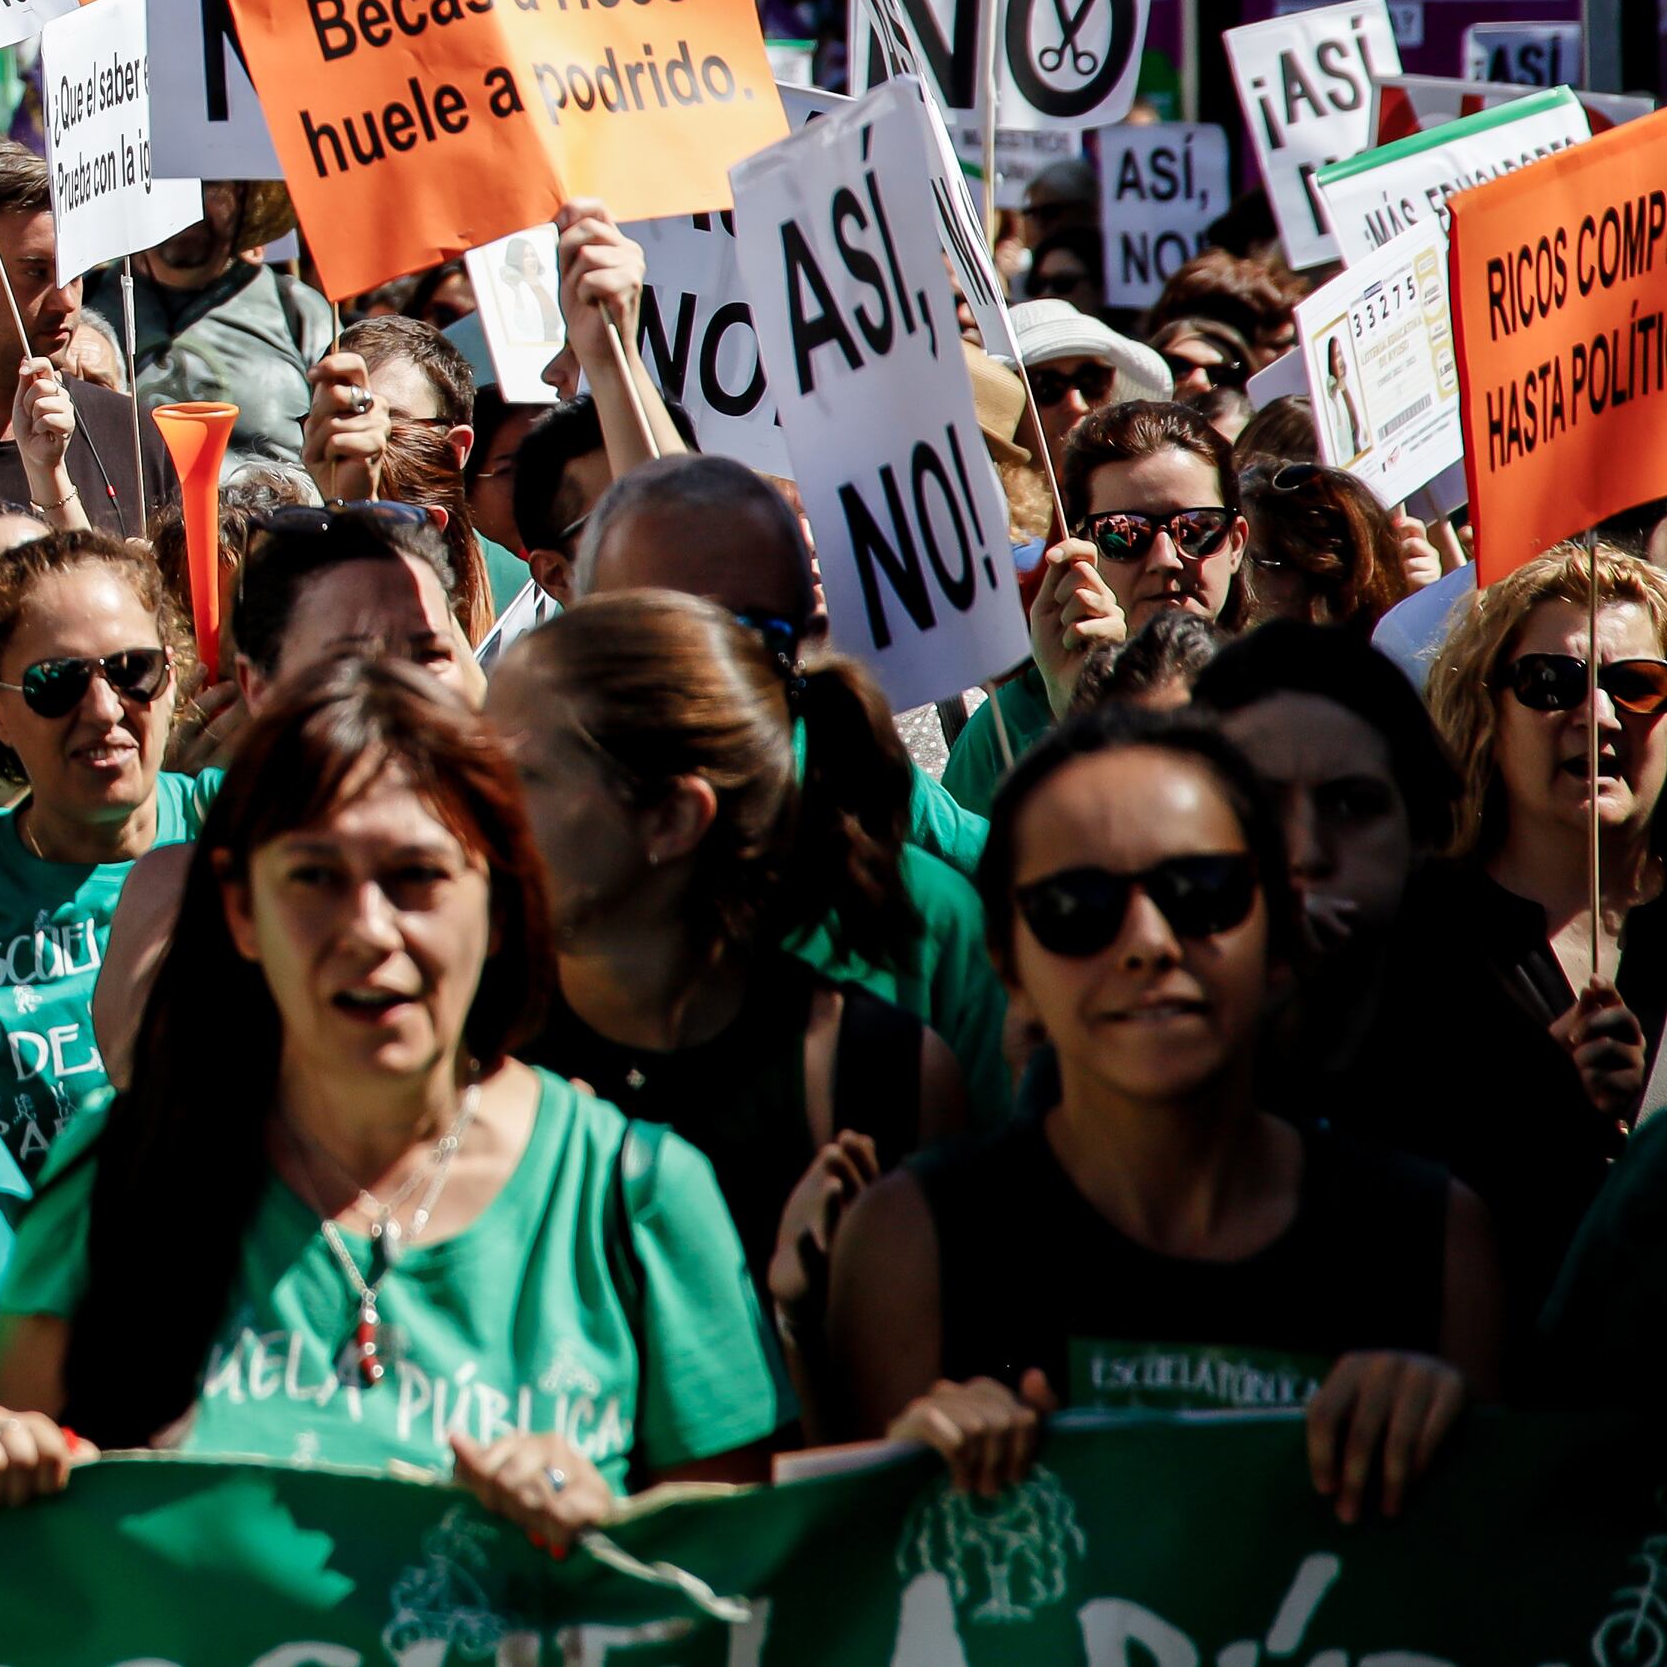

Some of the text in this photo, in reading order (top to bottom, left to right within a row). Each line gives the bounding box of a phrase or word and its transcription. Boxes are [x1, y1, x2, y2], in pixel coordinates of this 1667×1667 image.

[54, 52, 140, 149] ¿Que el saber
[299, 41, 754, 178] huele a podrido.
[1252, 15, 1378, 151] ¡ASÍ
[54, 151, 91, 234] ¡Prueba
[93, 149, 117, 195] con
[120, 133, 136, 189] la
[1117, 132, 1210, 211] ASÍ,
[778, 124, 940, 396] ASÍ,
[1353, 274, 1416, 339] 33275
[1487, 189, 1667, 342] RICOS COMP
[1487, 299, 1667, 473] HASTA POLÍTI
[838, 422, 998, 649] NO!
[8, 1022, 104, 1081] DE
